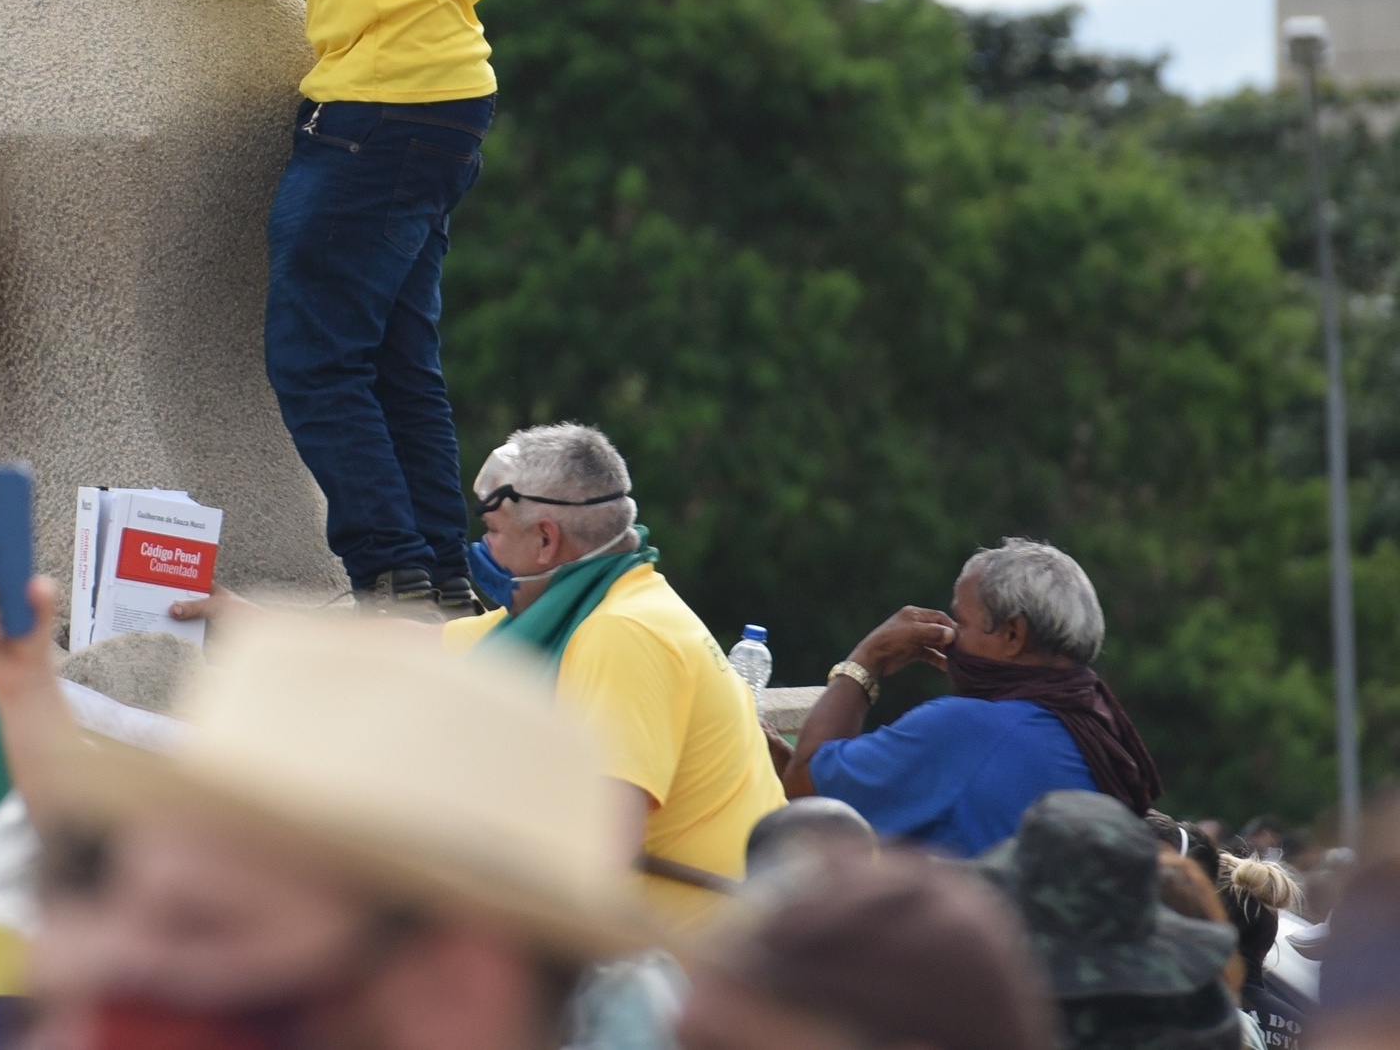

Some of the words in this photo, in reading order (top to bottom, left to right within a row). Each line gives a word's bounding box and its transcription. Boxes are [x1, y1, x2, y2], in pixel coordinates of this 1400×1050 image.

[141, 542, 173, 561] Código
[174, 548, 201, 565] Penal
[150, 558, 198, 578] Comentado
